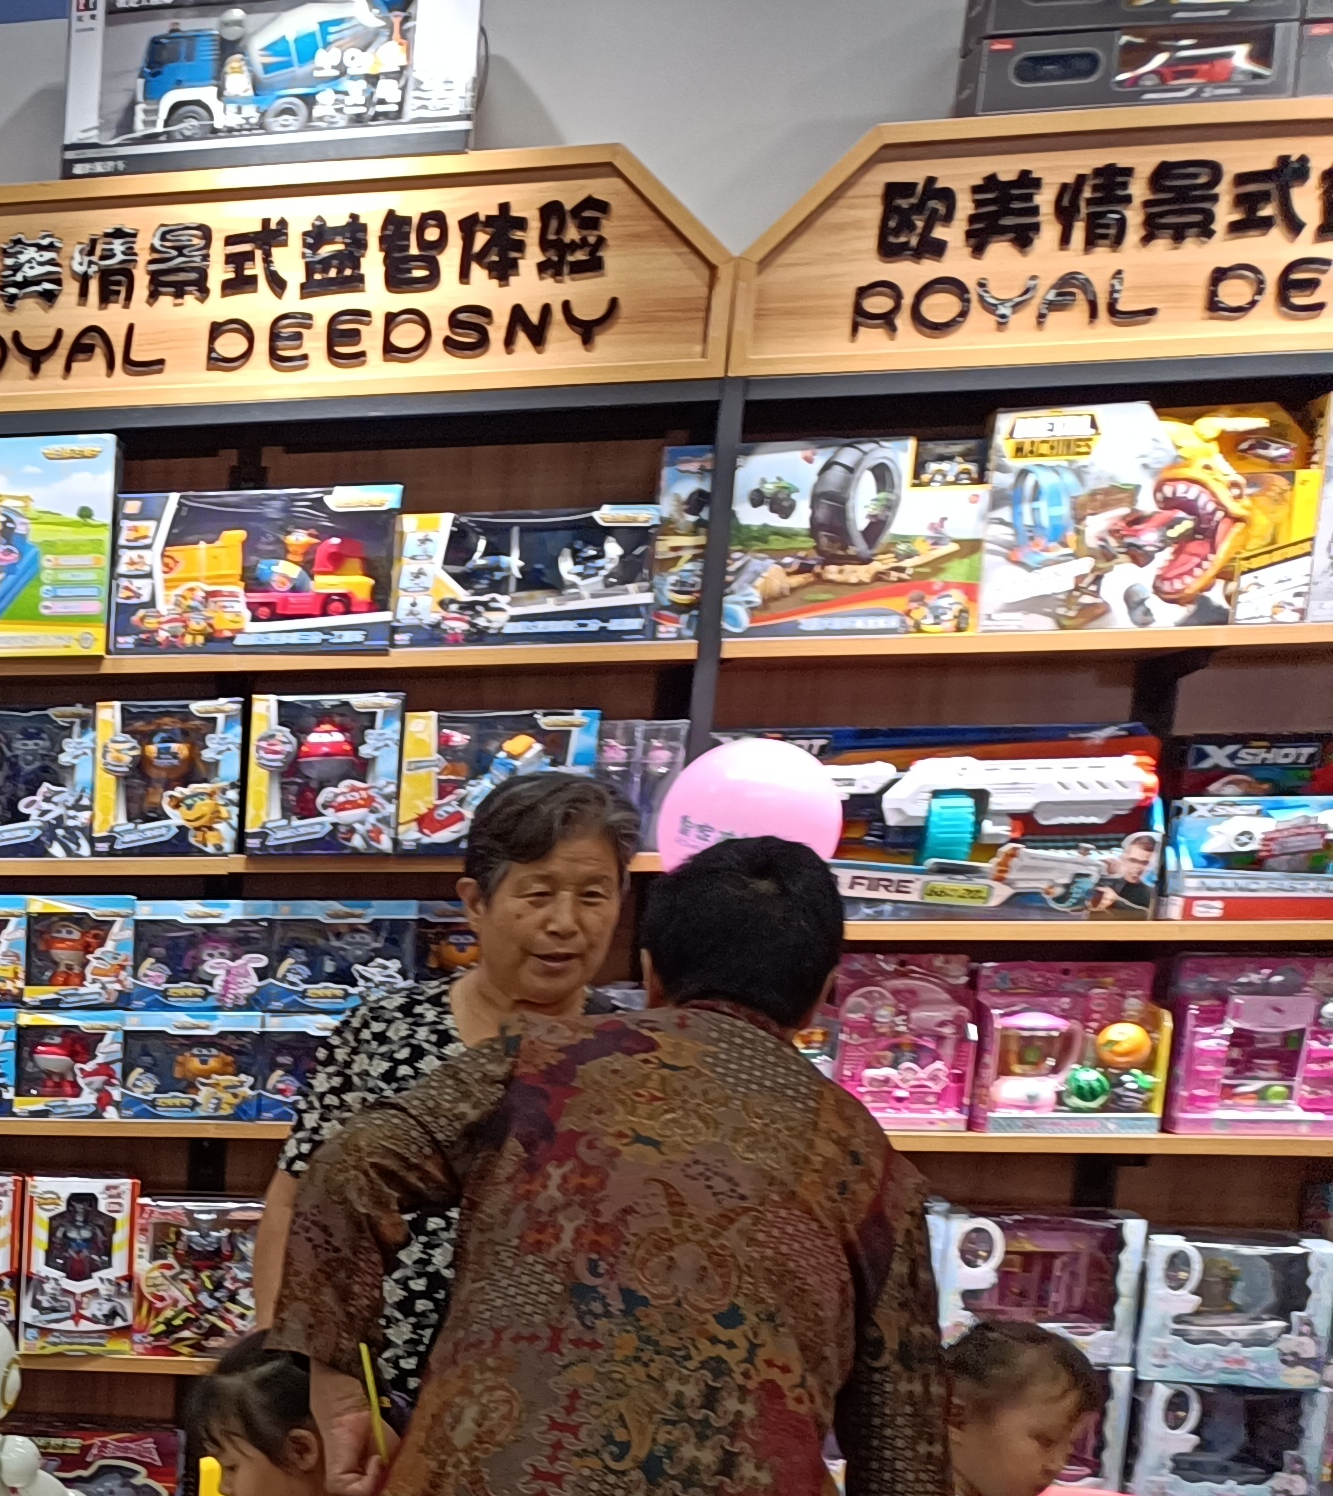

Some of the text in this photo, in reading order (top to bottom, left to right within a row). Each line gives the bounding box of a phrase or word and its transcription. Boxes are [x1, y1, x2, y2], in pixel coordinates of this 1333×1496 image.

[876, 153, 1333, 263] 欧美情景式
[205, 296, 620, 373] DEEDSNY
[850, 268, 1158, 343] ROYAL
[848, 875, 914, 895] FIRE
